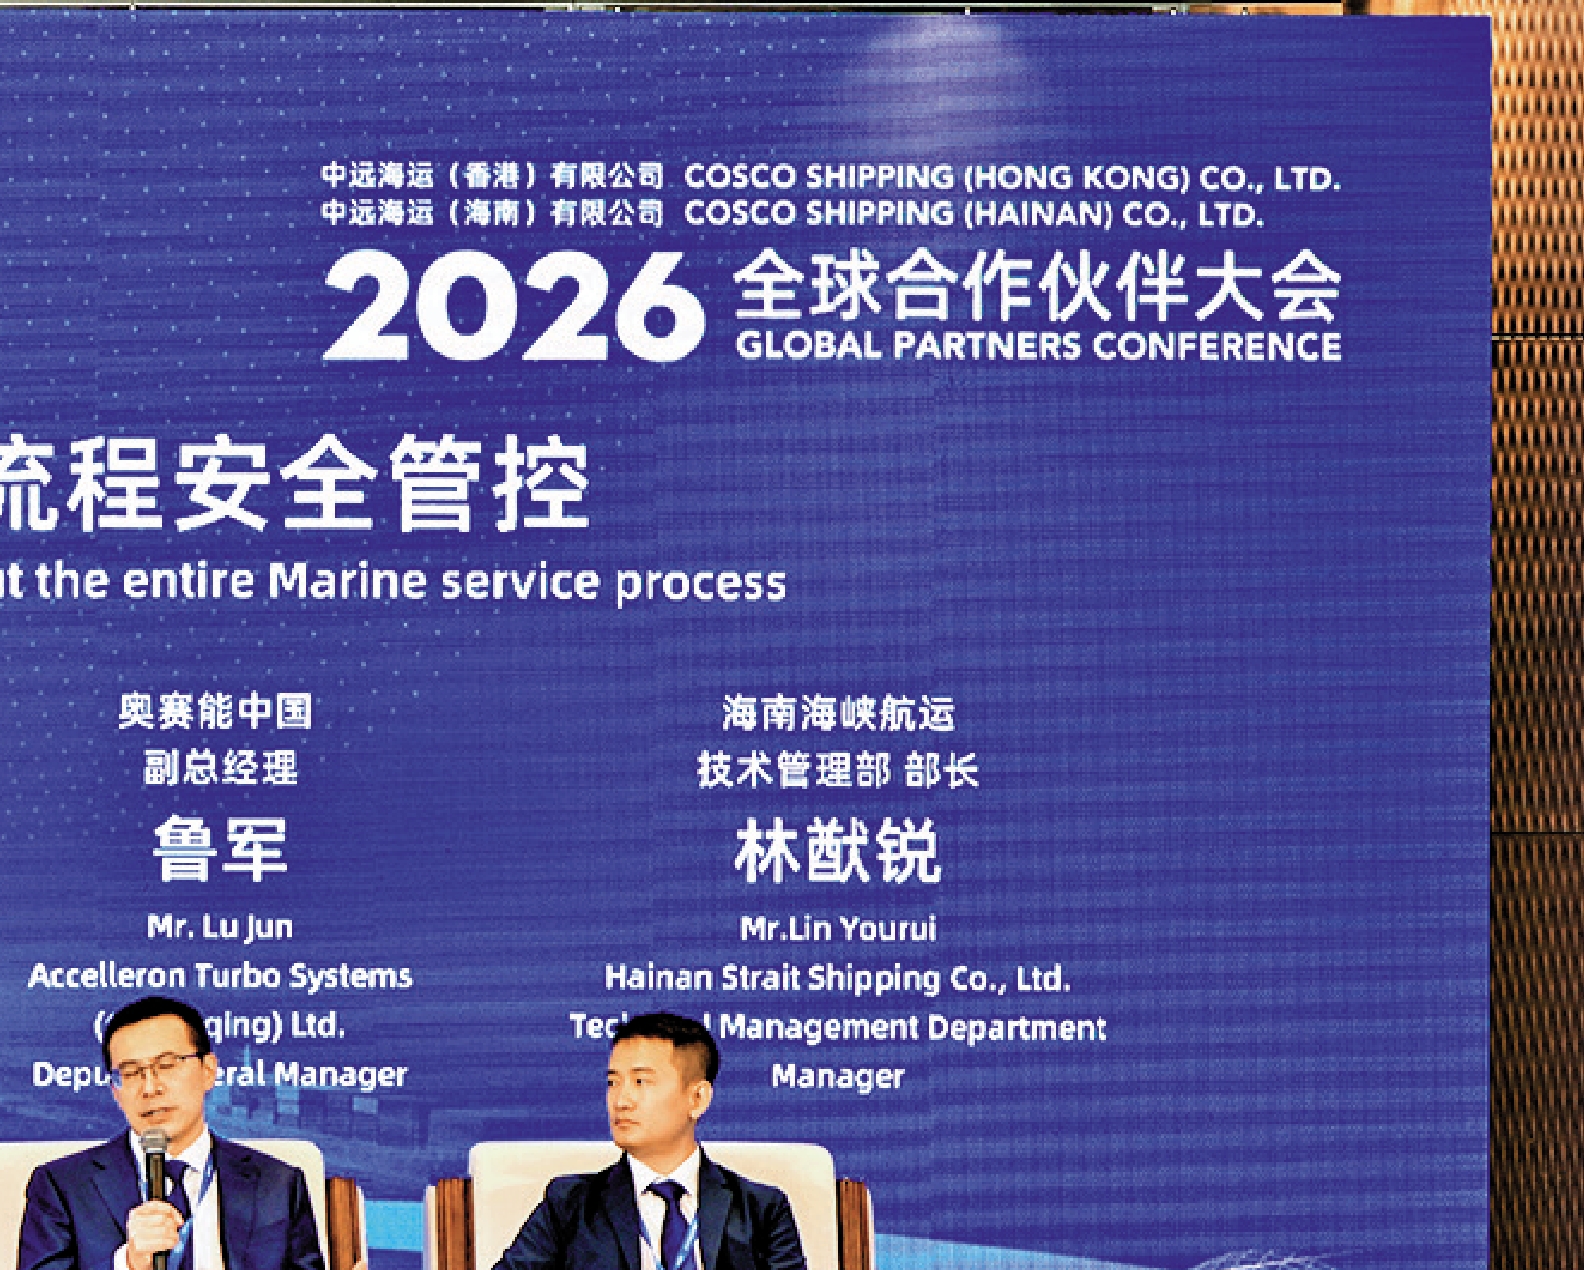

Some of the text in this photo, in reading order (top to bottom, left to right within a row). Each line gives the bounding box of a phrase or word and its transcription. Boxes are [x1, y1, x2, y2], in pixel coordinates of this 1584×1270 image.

[322, 160, 664, 190] 中远海运（香港）有限公司
[684, 162, 1340, 195] COSCO SHIPPING (HONG KONG) CO., LTD.
[322, 198, 664, 229] 中远海运（海南）有限公司
[684, 198, 1263, 231] COSCO SHIPPING (HAINAN) CO., LTD.
[732, 246, 1342, 325] 全球合作伙伴大会
[322, 248, 705, 363] 2026
[736, 330, 1342, 361] GLOBAL PARTNERS CONFERENCE
[34, 560, 111, 600] the
[123, 560, 254, 600] entire
[269, 560, 427, 600] Marine
[442, 560, 599, 600] service
[617, 569, 786, 610] process
[118, 689, 312, 730] 奥赛能中国
[722, 692, 956, 732] 海南海峡航运
[145, 747, 298, 787] 副总经理
[696, 749, 980, 790] 技术管理部 部长
[152, 814, 288, 883] 鲁军
[734, 816, 942, 885] 林猷锐
[147, 912, 293, 945] Mr. Lu Jun
[741, 915, 937, 941] Mr.Lin Yourui
[27, 960, 413, 996] Accelleron Turbo Systems
[605, 960, 1071, 998] Hainan Strait Shipping Co., Ltd.
[291, 1010, 345, 1039] Ltd.
[720, 1013, 920, 1046] Management
[928, 1013, 1107, 1048] Department
[32, 1058, 408, 1094] Depu eral Manager
[772, 1063, 906, 1094] Manager
